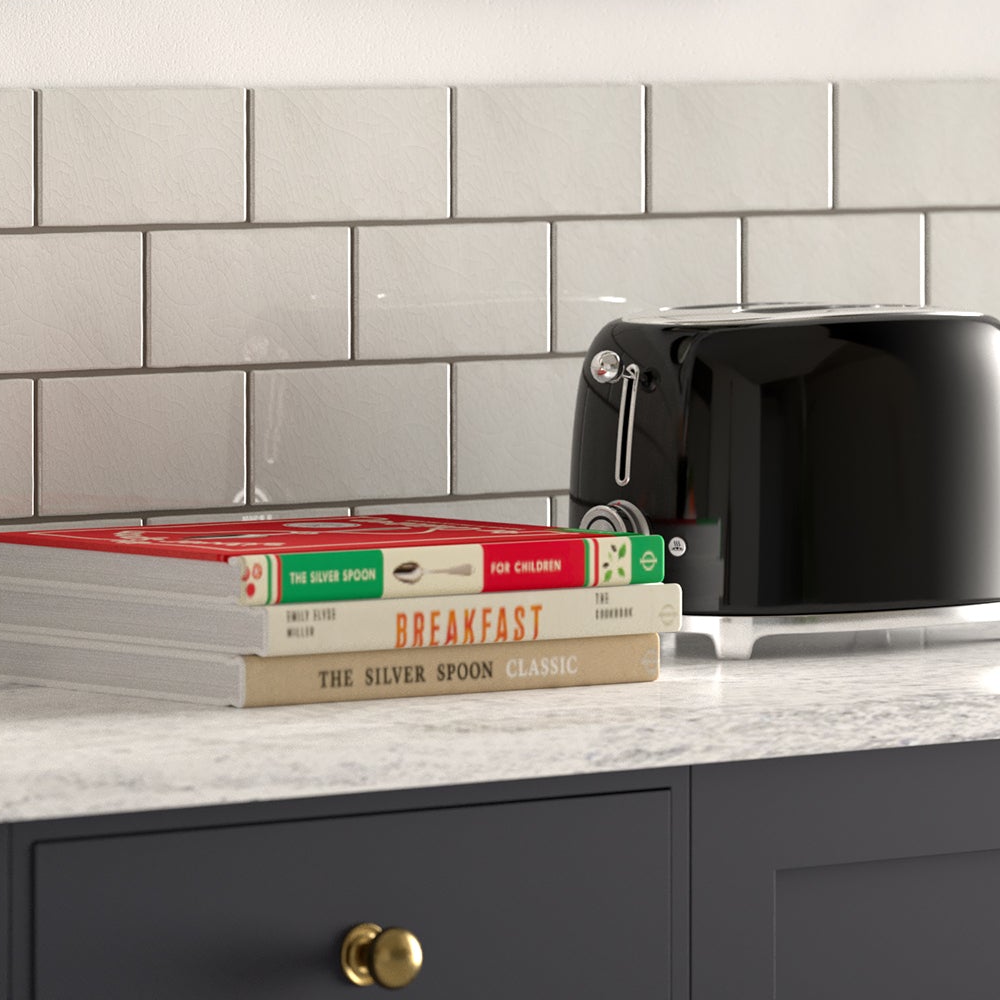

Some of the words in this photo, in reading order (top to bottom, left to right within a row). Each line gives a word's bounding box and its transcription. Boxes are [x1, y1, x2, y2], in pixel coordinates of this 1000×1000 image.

[289, 571, 307, 585] THE
[309, 569, 340, 584] SILVER
[342, 567, 377, 582] SPOON
[490, 561, 511, 575] FOR
[513, 558, 562, 574] CHILDREN
[394, 604, 544, 649] BREAKFAST
[318, 668, 354, 689] THE
[364, 664, 427, 687] SILVER
[436, 660, 494, 682] SPOON
[505, 655, 579, 679] CLASSIC
